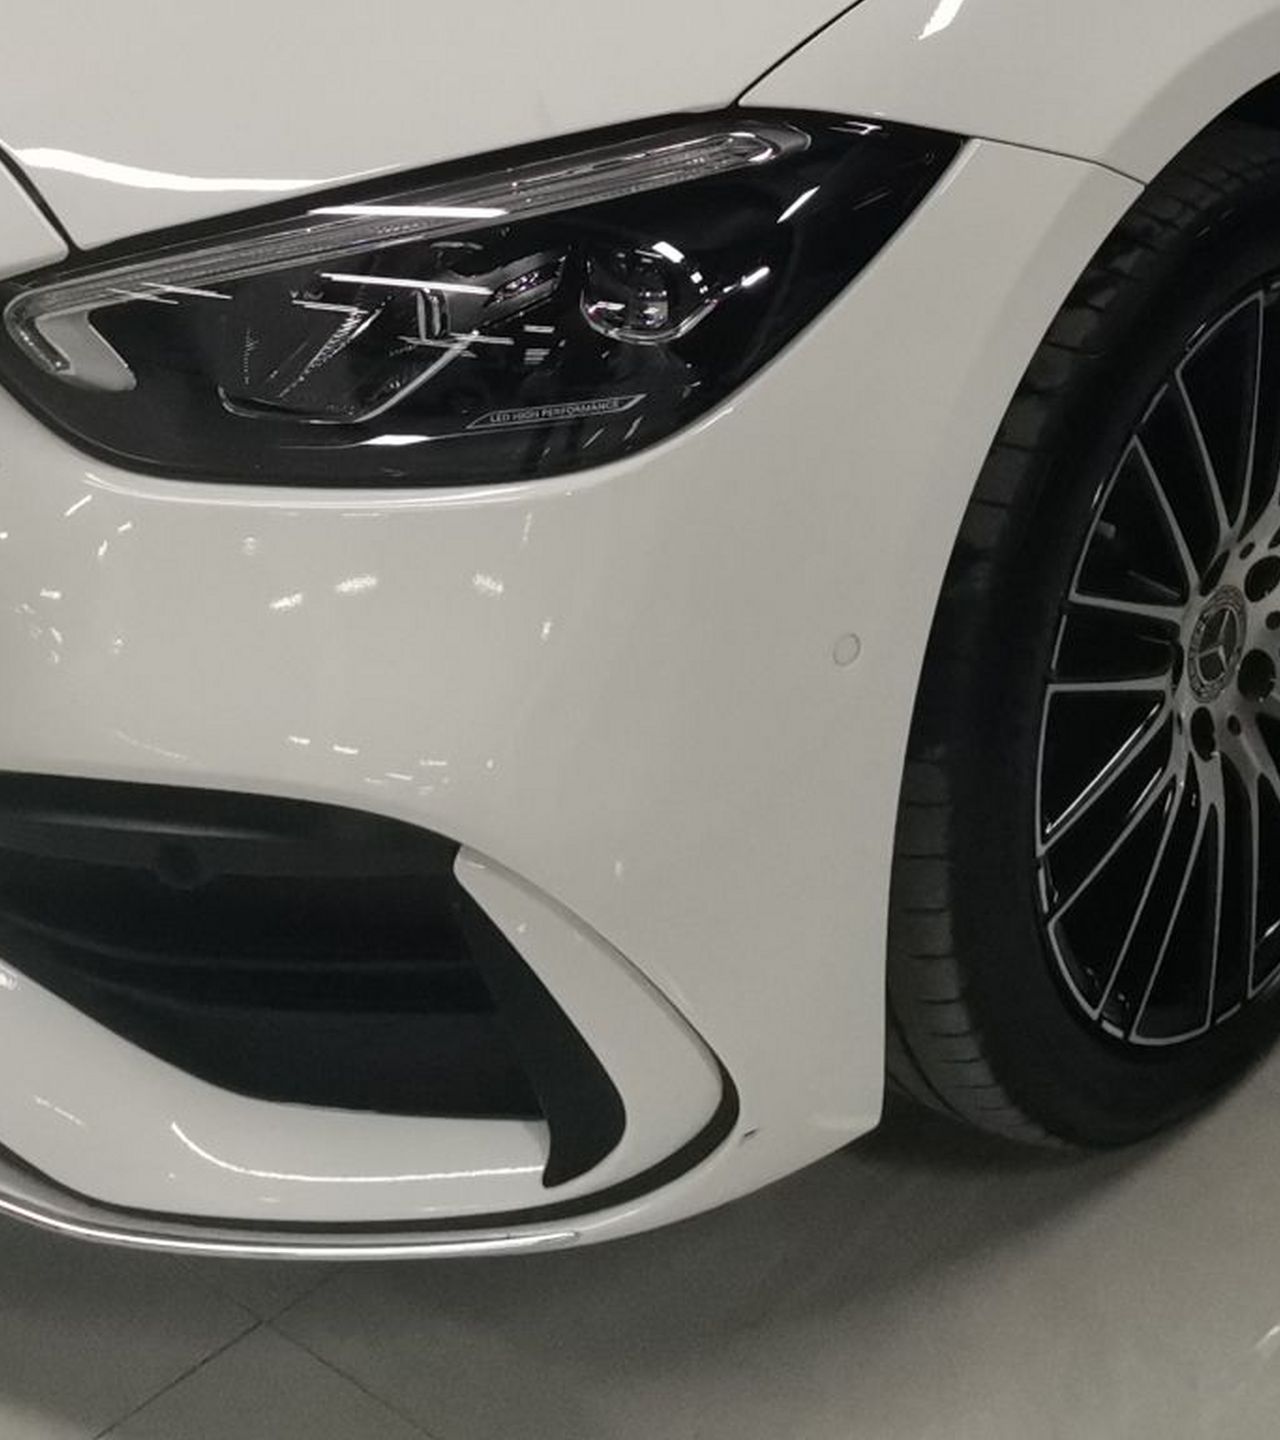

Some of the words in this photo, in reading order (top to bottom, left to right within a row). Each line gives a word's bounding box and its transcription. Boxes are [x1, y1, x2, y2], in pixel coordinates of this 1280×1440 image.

[489, 413, 510, 424] LED
[512, 410, 540, 421] HIGH
[541, 400, 620, 419] PERFORMANCE
